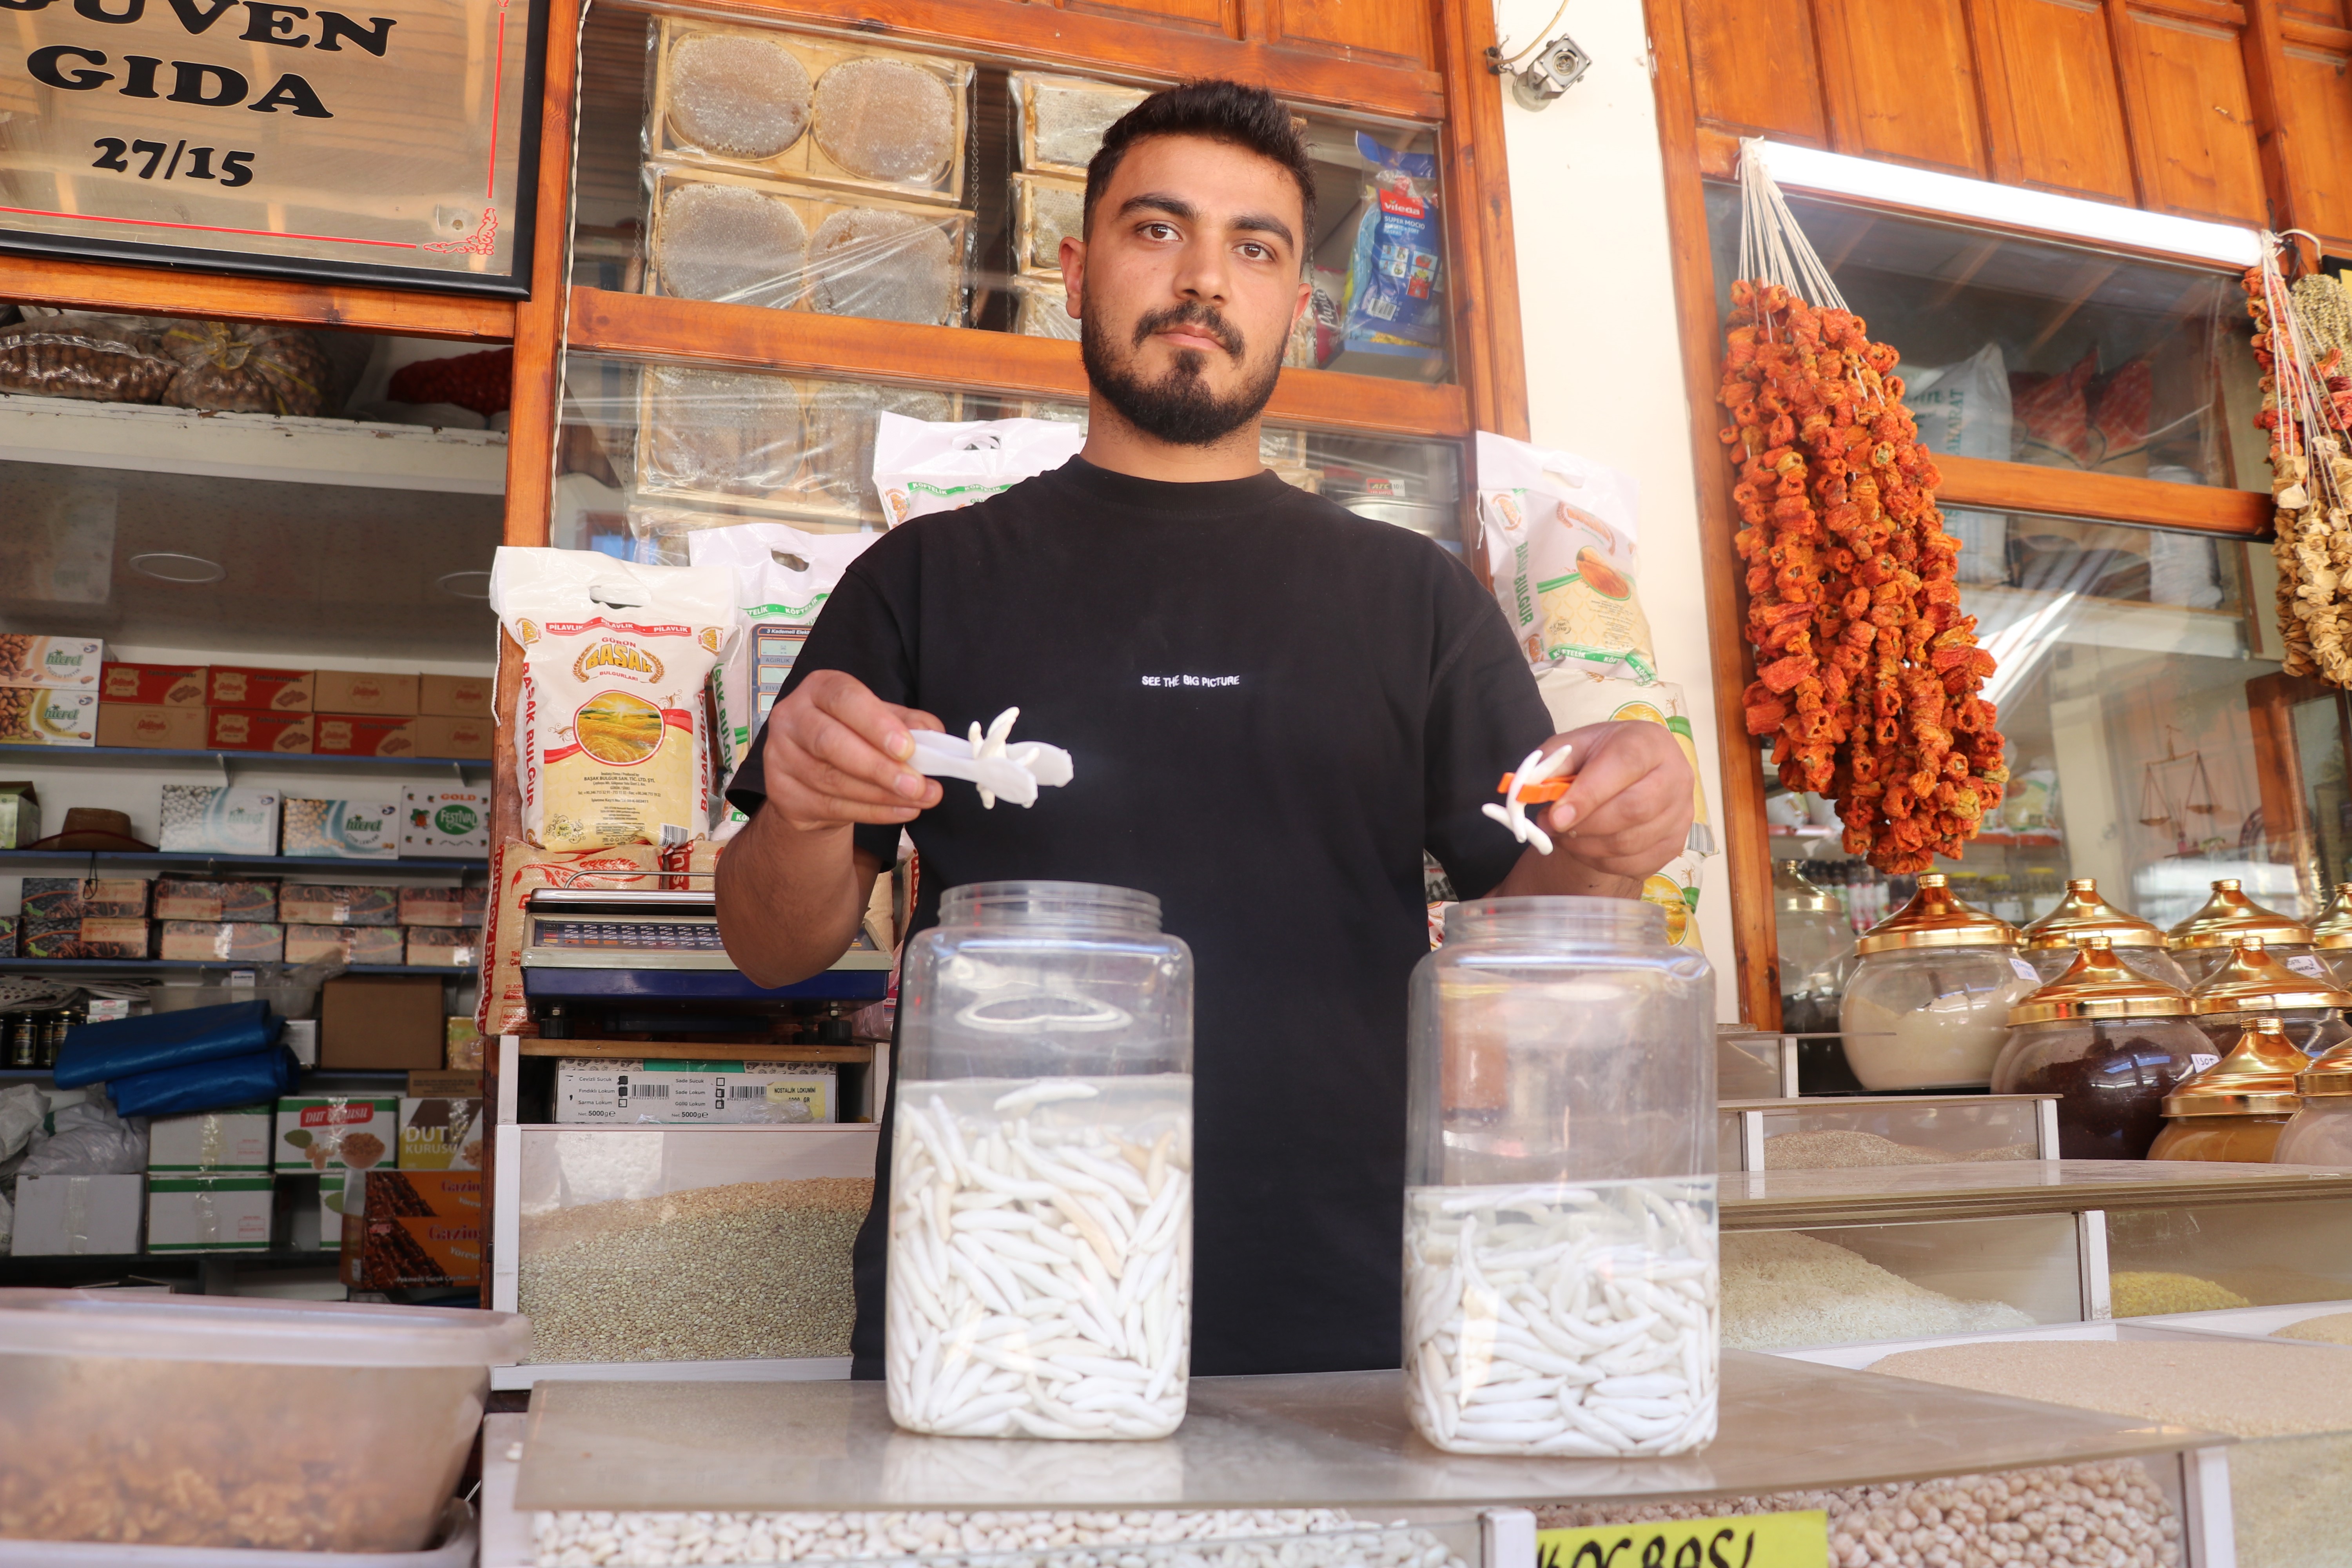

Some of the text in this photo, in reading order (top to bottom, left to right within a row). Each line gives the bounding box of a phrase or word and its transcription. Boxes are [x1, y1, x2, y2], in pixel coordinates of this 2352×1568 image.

[0, 0, 397, 58] VEN
[27, 45, 335, 119] GIDA
[92, 137, 256, 187] 27/15
[1385, 216, 1425, 230] SUPER MOCIO
[912, 483, 947, 495] KÖFTELİK
[785, 597, 818, 615] KÖFTELİK
[1514, 573, 1534, 627] BULGUR
[601, 618, 633, 629] PİLAVLIK
[602, 637, 637, 648] GÜRÜN
[599, 671, 639, 682] BULGURLARI
[1142, 674, 1240, 688] SEE THE BIG PICTURE
[523, 662, 536, 809] BAŞAK BULGUR
[441, 793, 476, 801] GOLD
[305, 1111, 326, 1123] DUT
[405, 1125, 448, 1143] DUT
[405, 1145, 458, 1154] KURUSU
